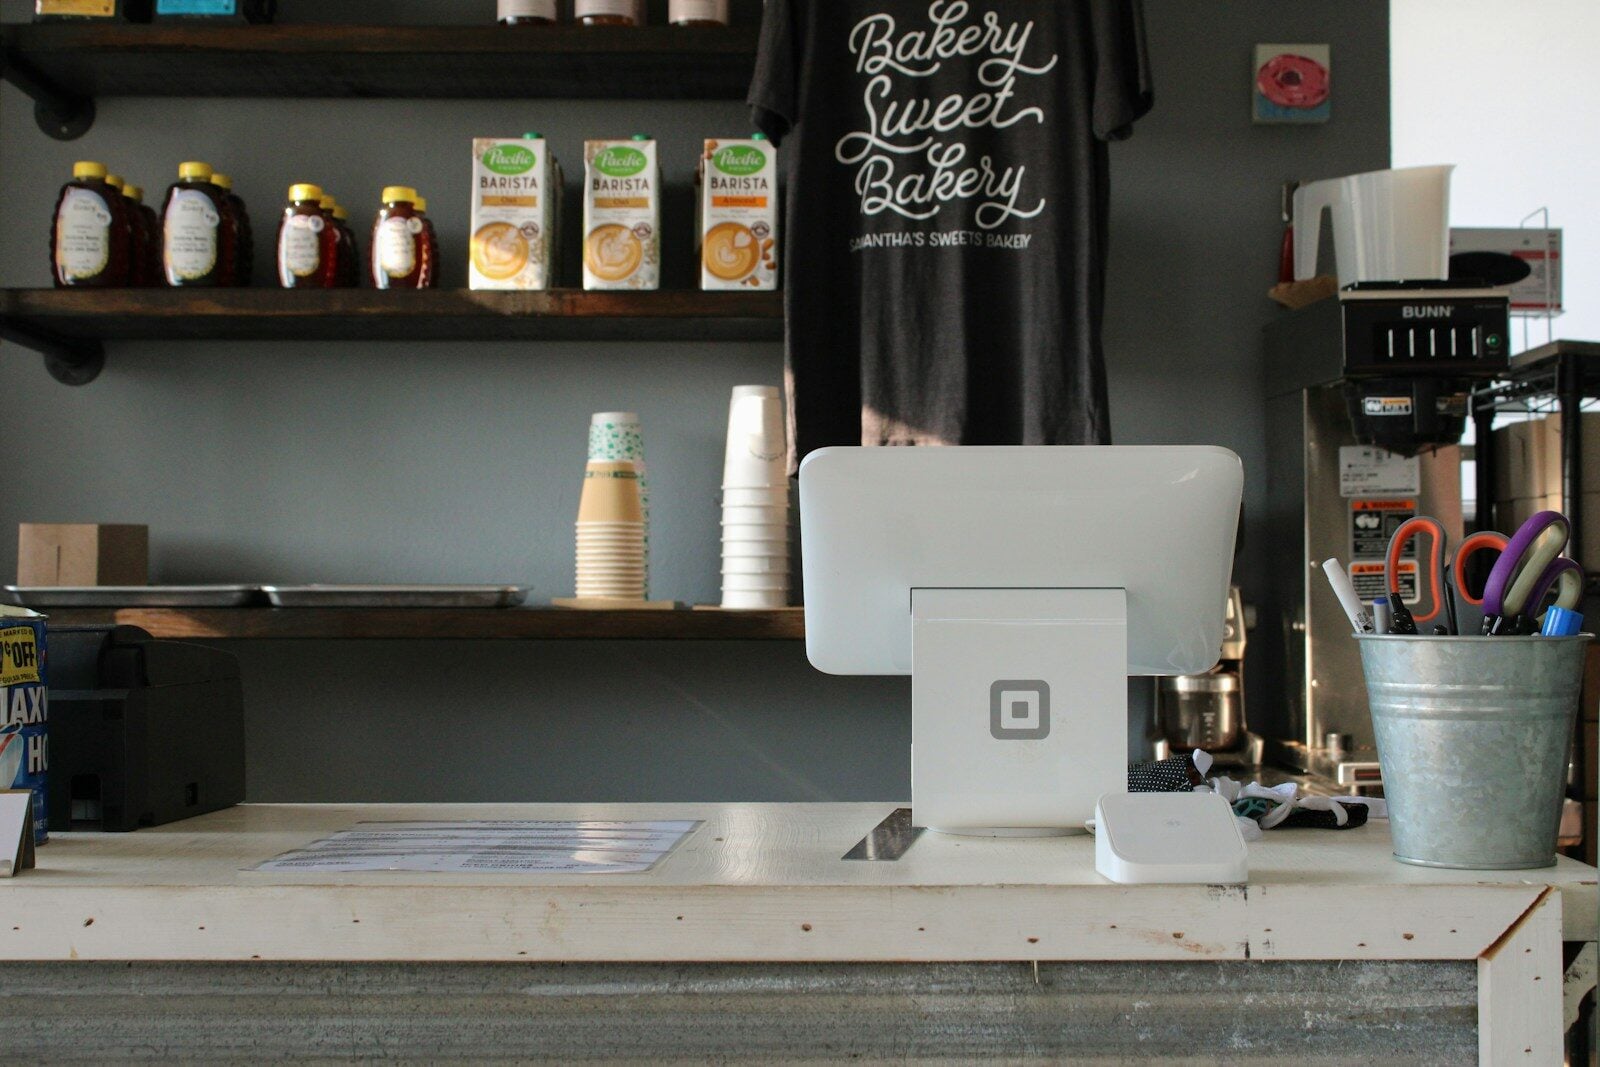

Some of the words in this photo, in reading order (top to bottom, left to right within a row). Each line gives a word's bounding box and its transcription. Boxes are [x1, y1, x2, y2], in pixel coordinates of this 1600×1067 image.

[848, 0, 1058, 87] Bakery
[835, 74, 1044, 164] Sweet
[480, 176, 538, 189] BARISTA
[592, 178, 650, 191] BARISTA
[710, 177, 769, 190] BARISTA
[855, 142, 1046, 229] Bakery
[929, 230, 982, 247] SWEETS
[1402, 305, 1451, 318] BUNN
[11, 641, 35, 668] OFF
